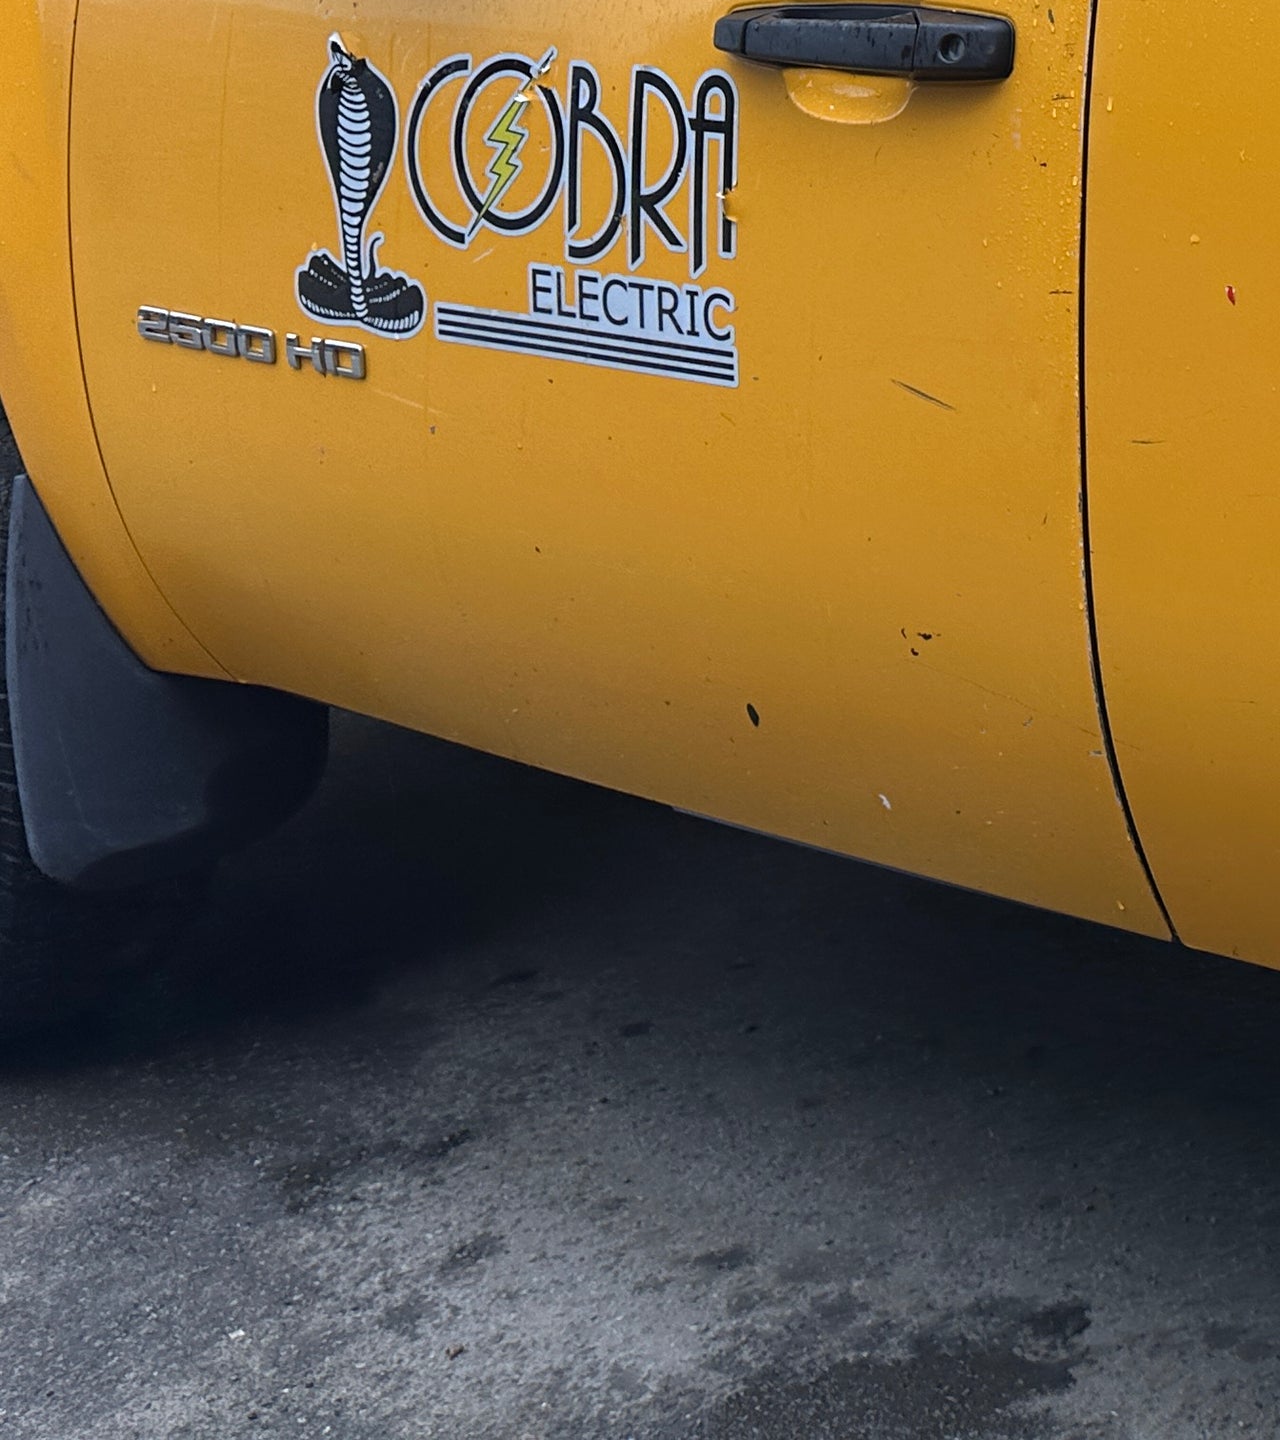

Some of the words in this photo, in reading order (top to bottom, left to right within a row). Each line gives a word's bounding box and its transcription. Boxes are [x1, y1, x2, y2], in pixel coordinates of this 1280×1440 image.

[407, 54, 737, 274] COBRA
[531, 267, 734, 341] ELECTRIC
[137, 305, 276, 363] 2500
[286, 333, 365, 379] HD
